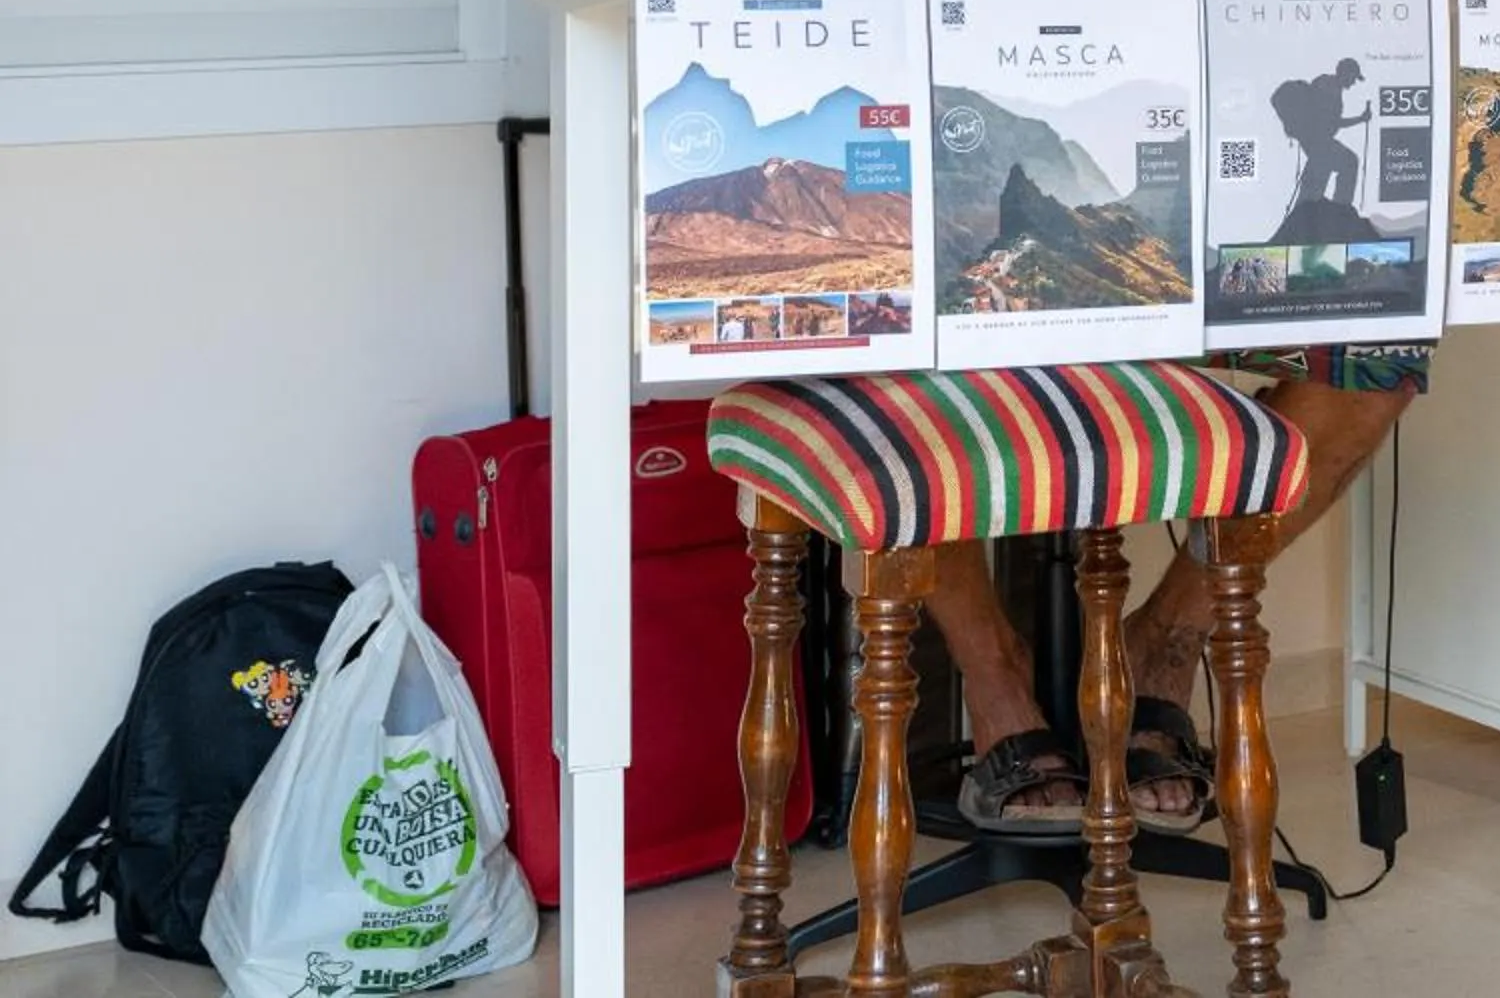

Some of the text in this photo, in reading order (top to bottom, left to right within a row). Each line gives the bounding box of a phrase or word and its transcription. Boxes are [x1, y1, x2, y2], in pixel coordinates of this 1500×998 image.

[1225, 3, 1410, 22] CHINYERO
[689, 20, 871, 49] TEIDE
[998, 44, 1124, 67] MASCA
[1381, 89, 1429, 112] 35€
[869, 108, 901, 126] 55€
[1147, 109, 1185, 128] 35€
